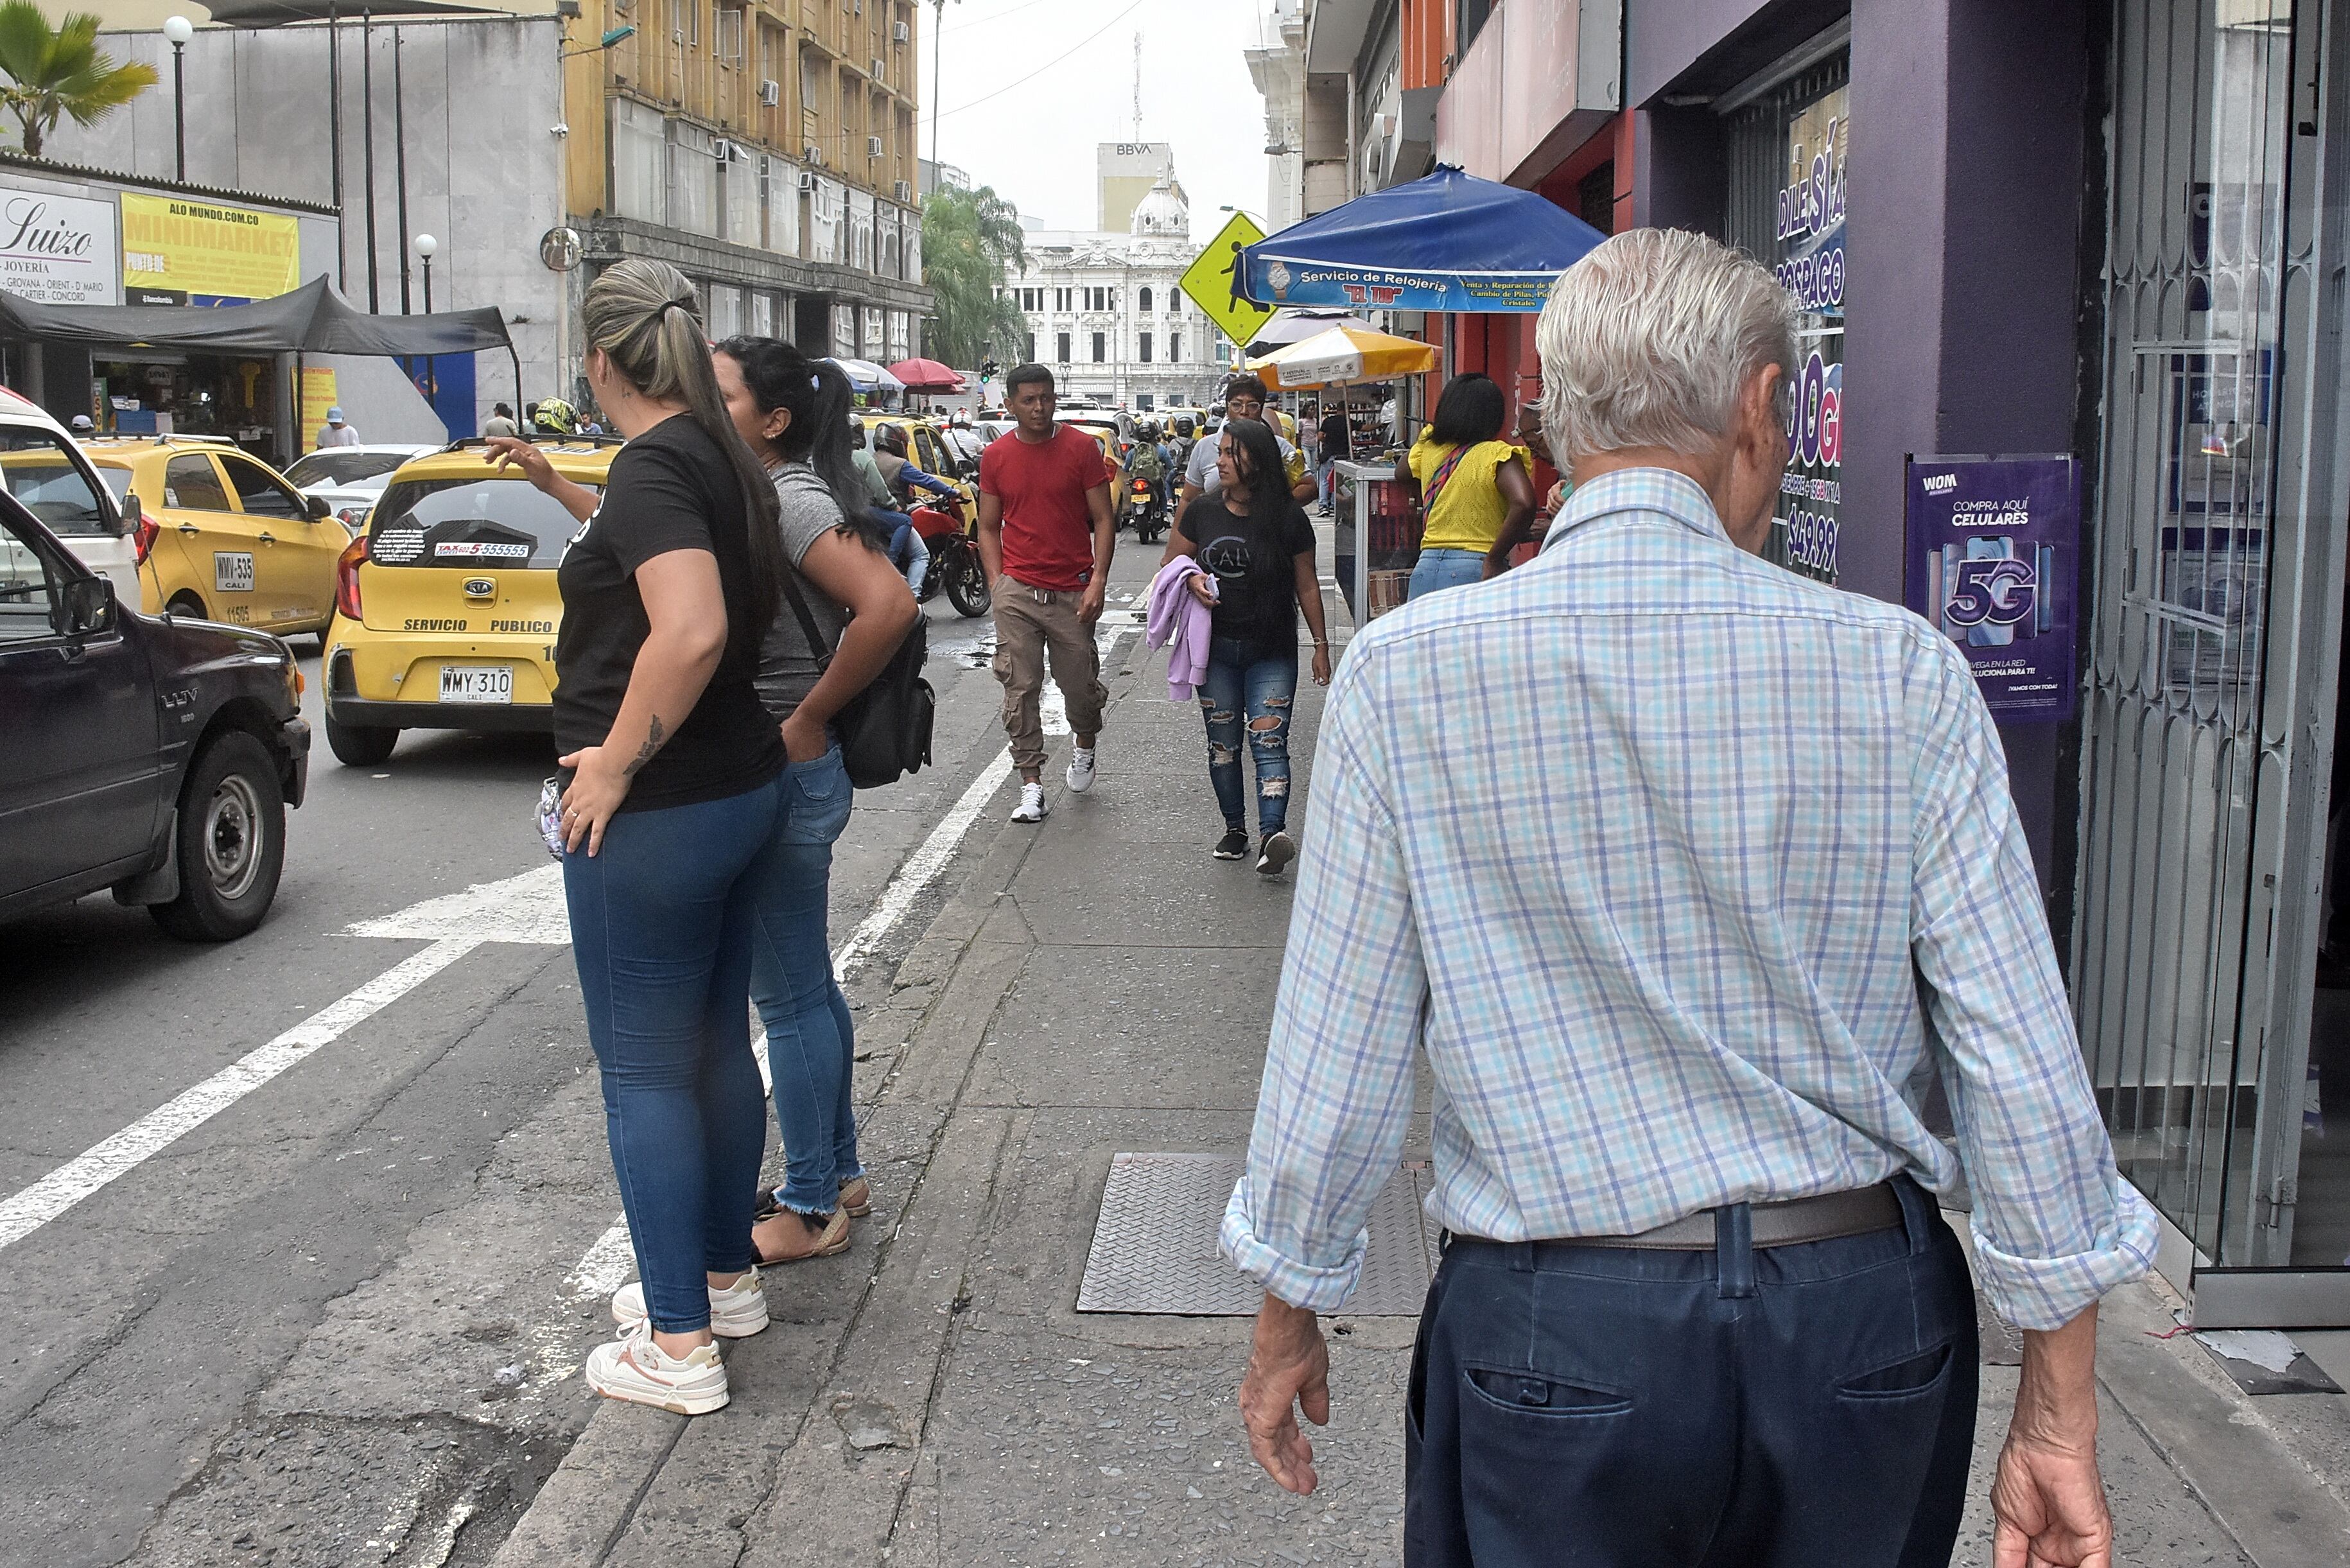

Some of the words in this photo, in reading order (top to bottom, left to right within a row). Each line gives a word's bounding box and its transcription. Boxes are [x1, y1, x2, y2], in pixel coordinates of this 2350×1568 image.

[1117, 144, 1151, 155] BBVA
[1777, 178, 1809, 241] DILE
[1809, 116, 1838, 236] SÍ
[170, 203, 186, 216] ALO
[189, 207, 259, 225] MUNDO.COM.CO
[125, 211, 292, 257] MINIMARKET
[4, 260, 49, 274] JOYERÍA
[7, 277, 40, 288] GROVANA
[47, 279, 70, 290] ORIENT
[1301, 270, 1359, 283] Servicio
[1362, 272, 1380, 283] de
[1384, 274, 1447, 293] Relojería
[1492, 281, 1535, 290] Reparación
[20, 290, 46, 301] CARTIER
[52, 291, 85, 301] CONCORD
[1922, 474, 1957, 491] WOM
[1953, 500, 1999, 512] COMPRA
[2002, 496, 2030, 512] AQUÍ
[1952, 512, 2028, 527] CELULARES
[1787, 503, 1840, 576] $49.99
[469, 584, 488, 592] KIA
[1944, 558, 2037, 626] 5G
[227, 605, 250, 623] 11505
[404, 619, 467, 631] SERVICIO
[491, 620, 552, 632] PUBLICO
[161, 687, 198, 707] LUV
